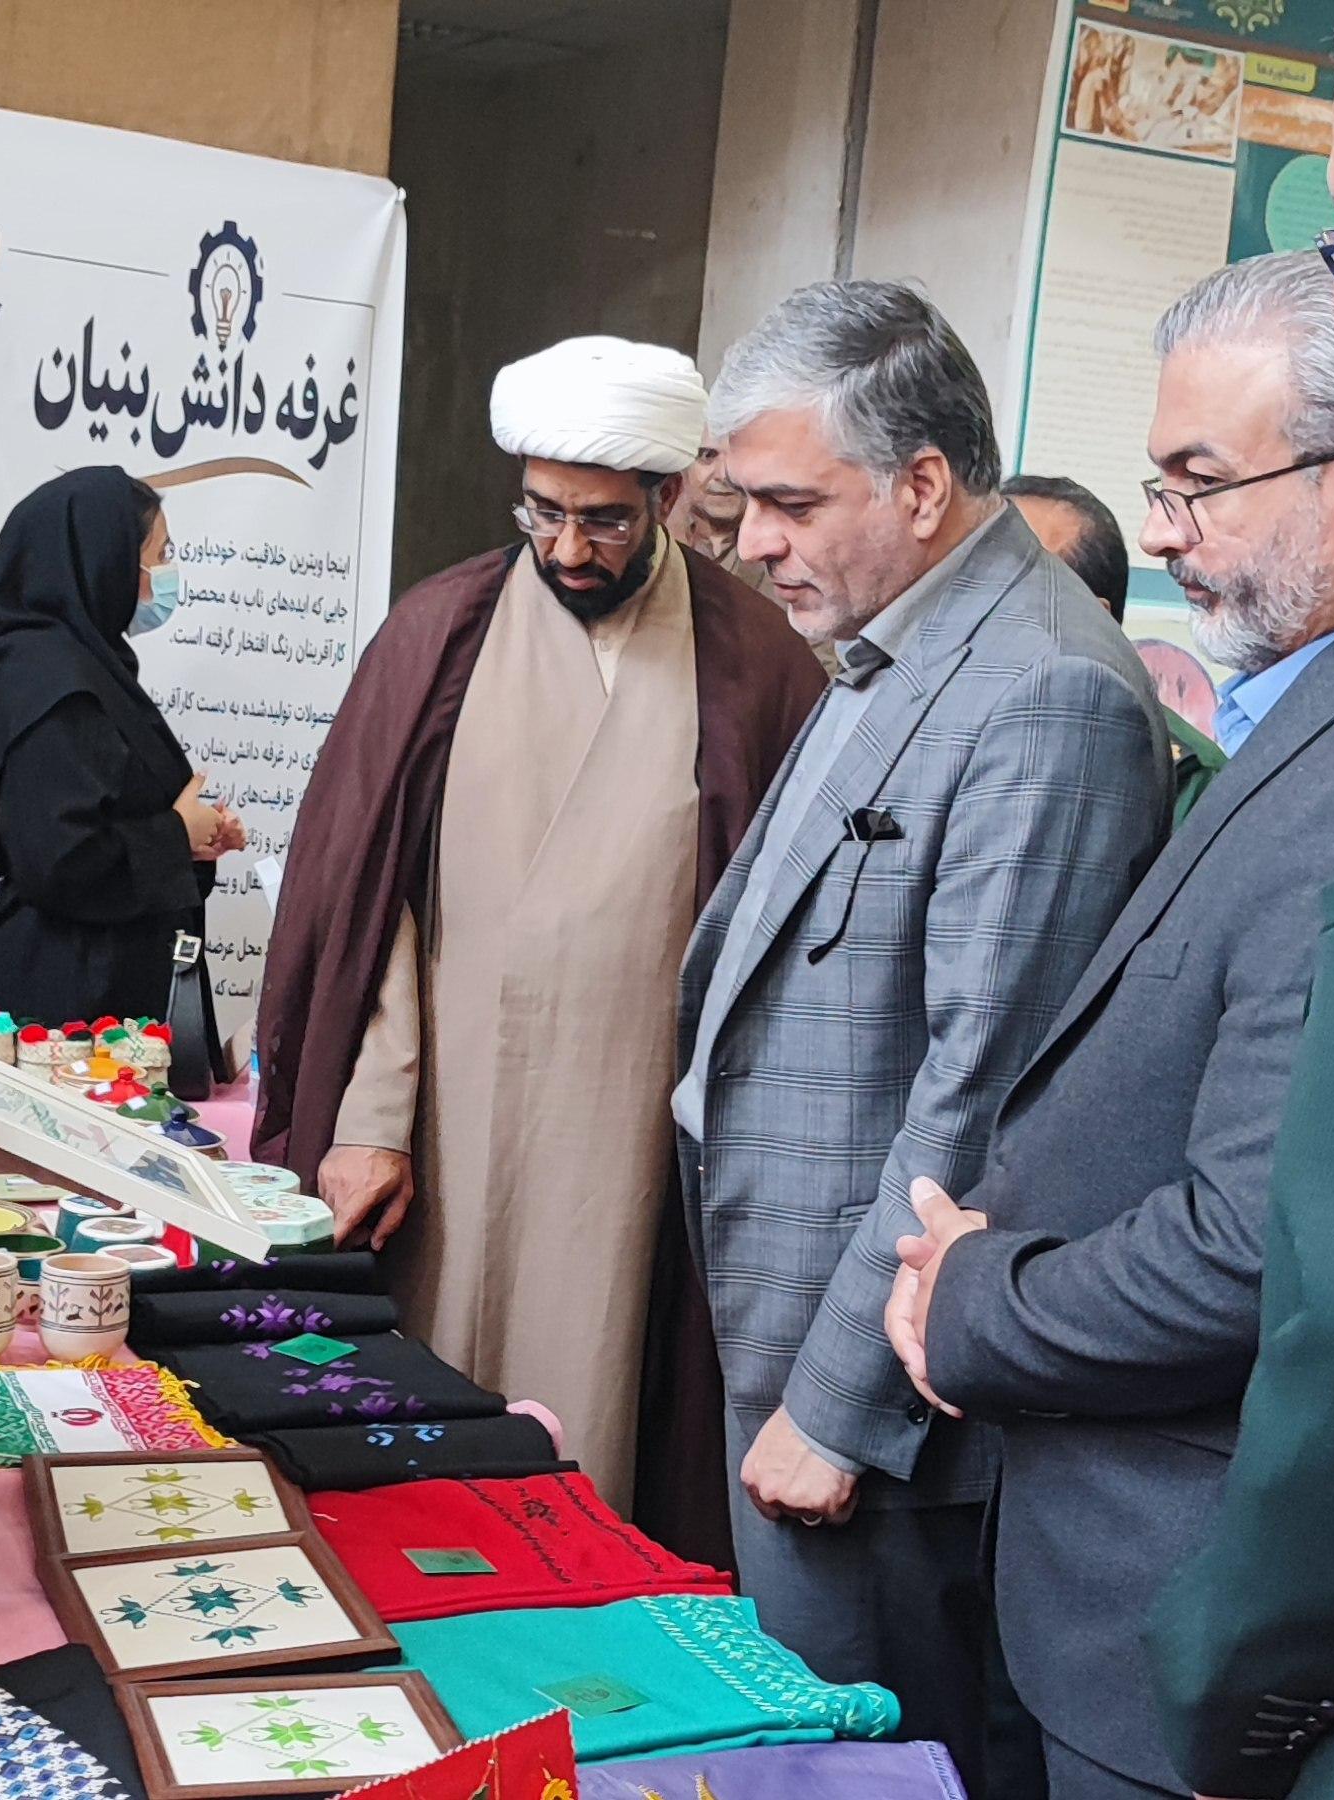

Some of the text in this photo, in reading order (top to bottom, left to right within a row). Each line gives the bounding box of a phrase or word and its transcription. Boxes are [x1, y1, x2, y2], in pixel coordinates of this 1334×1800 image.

[275, 353, 361, 470] غرفه
[178, 536, 237, 566] خودباوری
[289, 553, 324, 578] ویترین
[326, 551, 351, 580] اینجا
[177, 579, 226, 607] محصول
[229, 590, 242, 612] به
[243, 587, 265, 613] ناب
[312, 596, 324, 615] که
[323, 598, 348, 624] جایی
[205, 625, 235, 656] گرفته
[235, 630, 270, 657] افتخار
[271, 633, 293, 662] رنگ
[149, 686, 195, 716] کارآفرینا
[196, 696, 227, 714] دست
[229, 700, 240, 721] به
[293, 702, 336, 730] حصولات
[262, 741, 284, 769] غرفه
[286, 750, 299, 770] در
[236, 936, 263, 962] محل
[214, 978, 254, 997] است که
